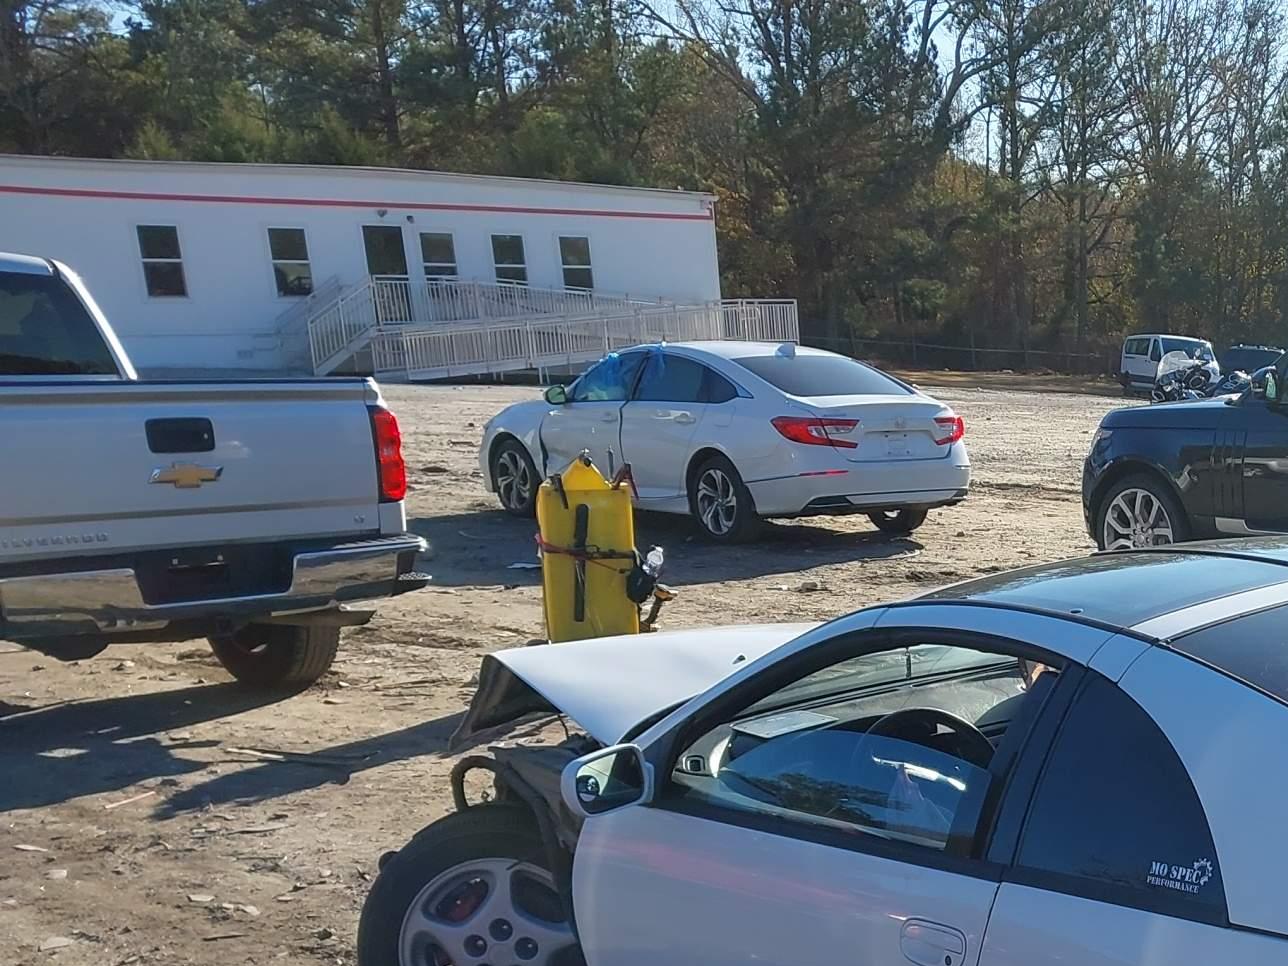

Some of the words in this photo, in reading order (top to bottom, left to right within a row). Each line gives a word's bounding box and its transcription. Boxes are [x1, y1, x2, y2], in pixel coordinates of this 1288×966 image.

[0, 532, 109, 549] ILVERADO
[1150, 861, 1168, 877] MO
[1170, 865, 1202, 884] SPEC
[1146, 875, 1200, 894] PERFORMANCE
